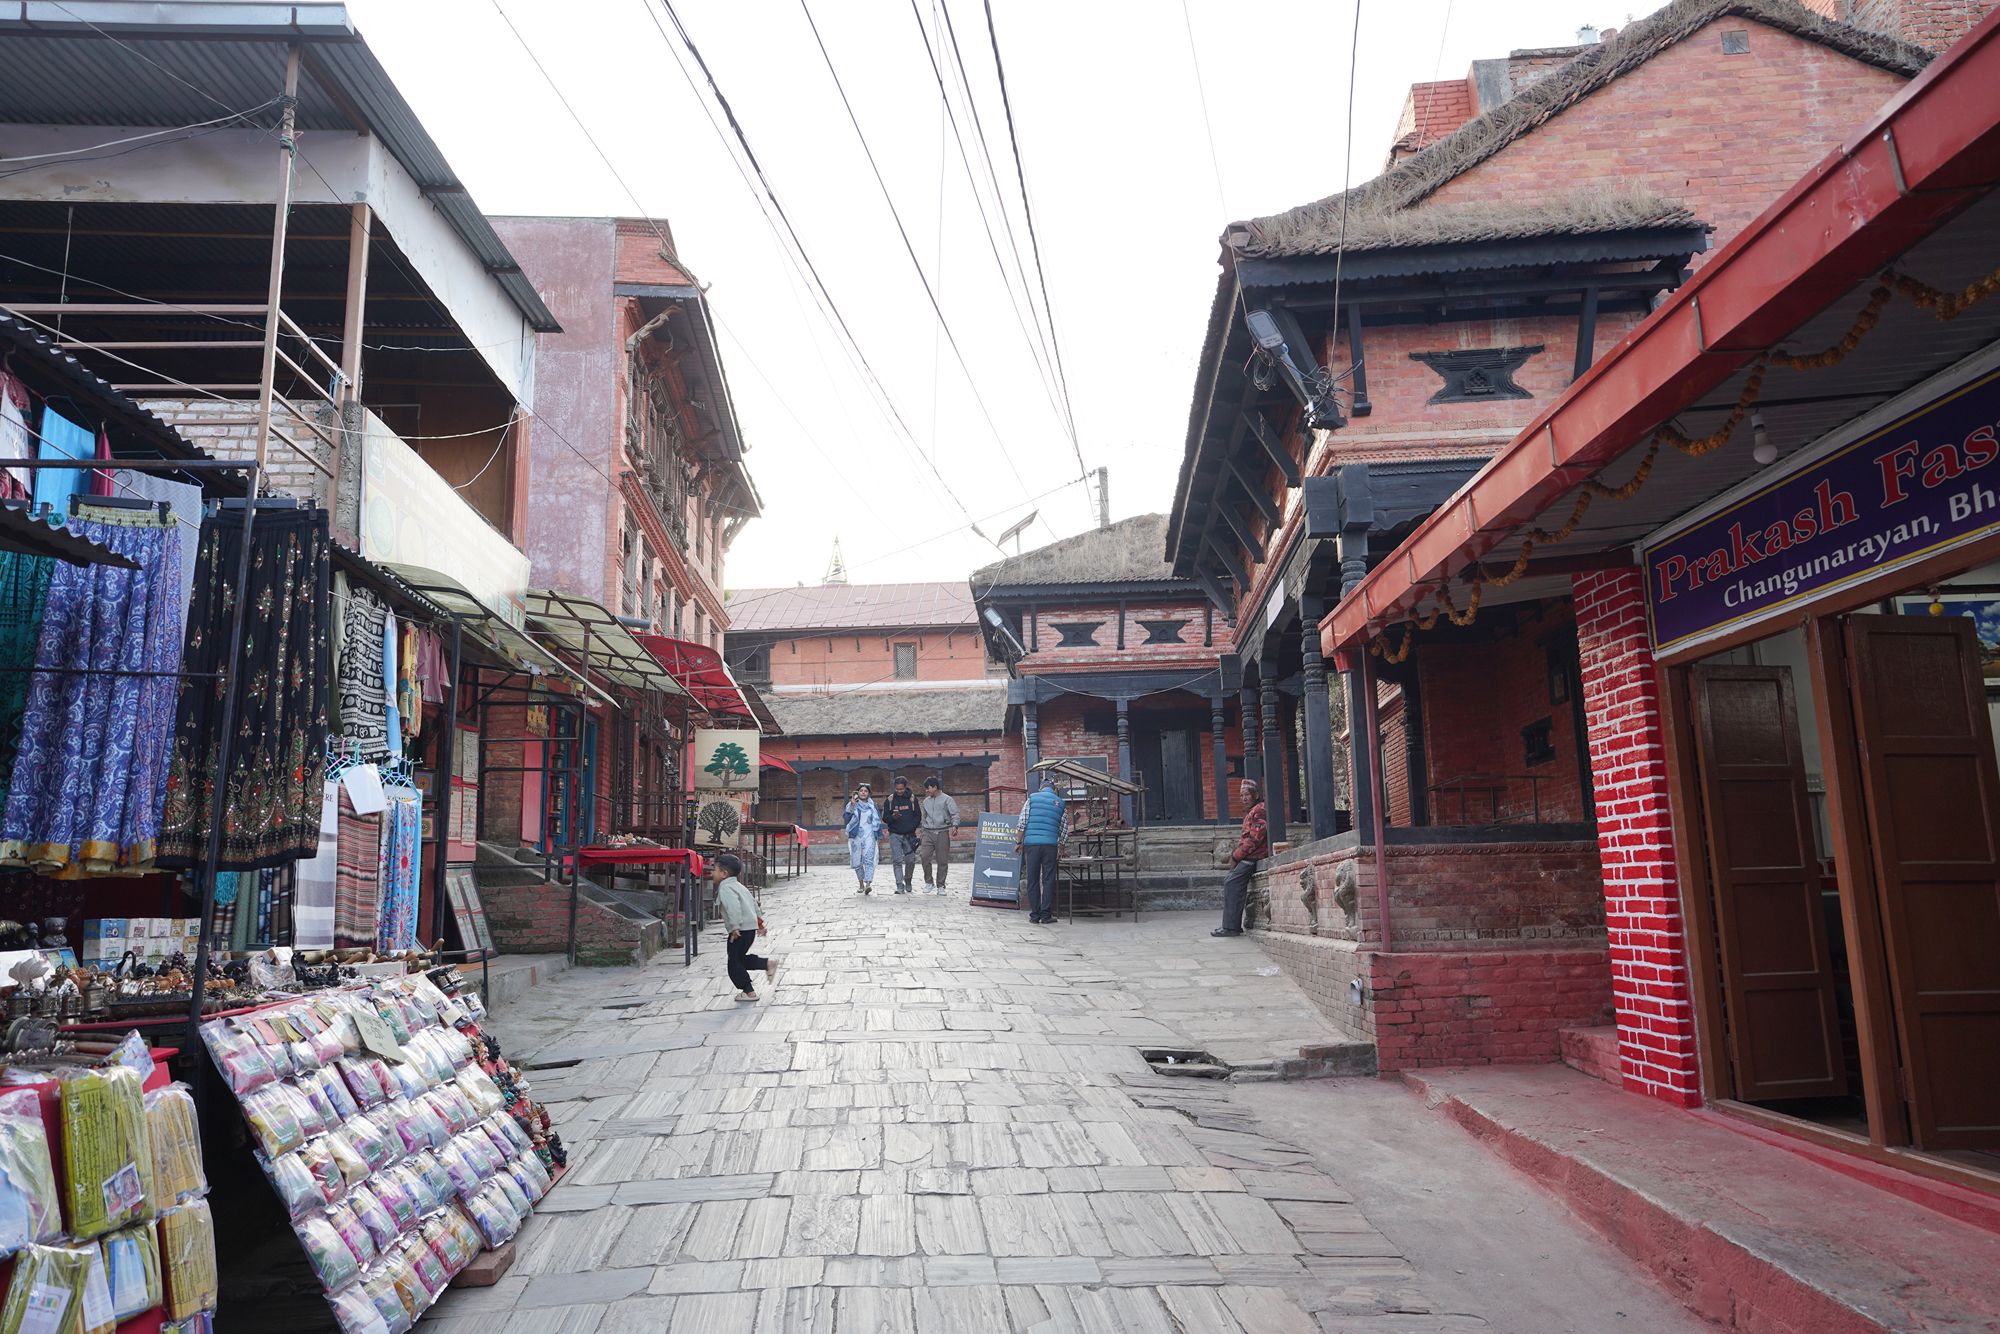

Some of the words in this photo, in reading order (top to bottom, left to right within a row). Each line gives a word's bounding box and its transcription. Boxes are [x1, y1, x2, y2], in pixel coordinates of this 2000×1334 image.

[1656, 478, 1860, 604] Prakash
[1873, 420, 2000, 509] Fas
[1724, 515, 1941, 608] Changunarayan,
[1949, 482, 2000, 522] Bh
